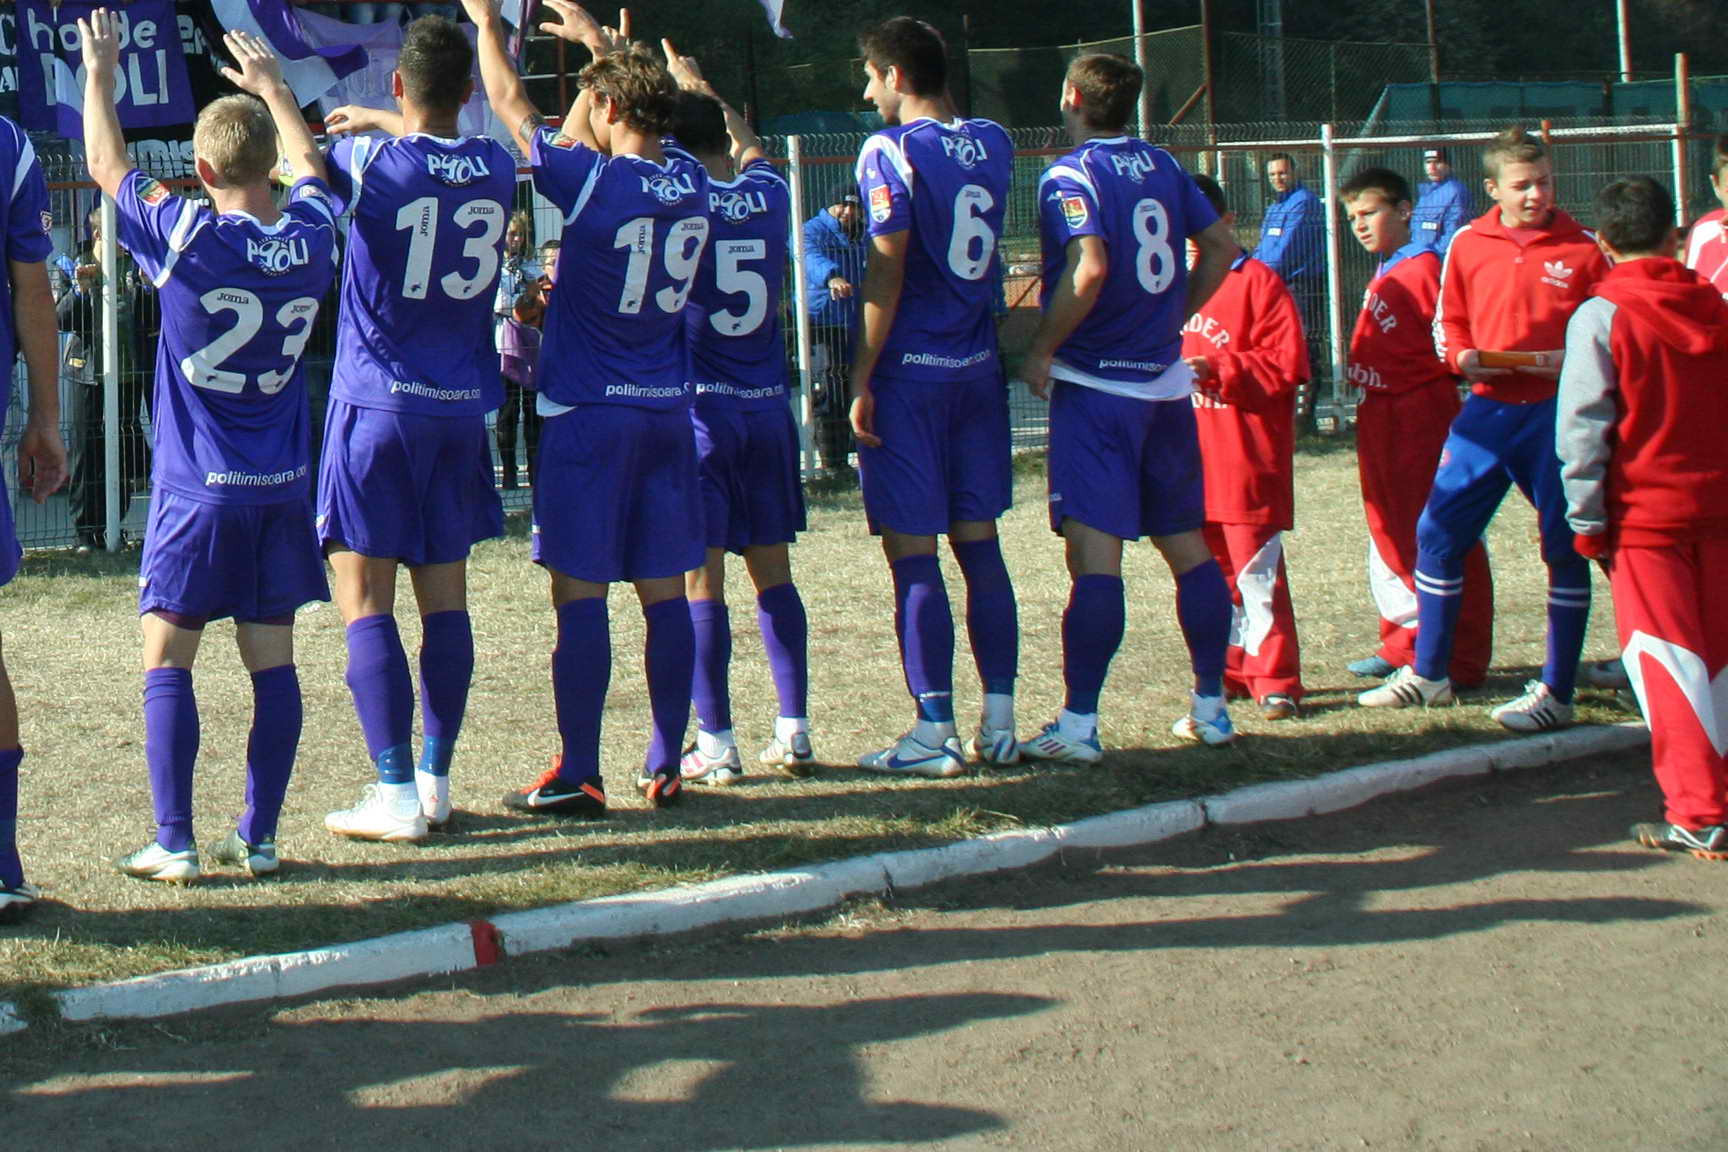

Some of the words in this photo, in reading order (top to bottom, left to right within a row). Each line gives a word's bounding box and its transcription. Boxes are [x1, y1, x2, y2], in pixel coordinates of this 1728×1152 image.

[396, 196, 505, 301] 13
[613, 215, 710, 314] 19
[947, 183, 995, 281] 6
[1132, 197, 1175, 295] 8
[708, 238, 768, 337] 5
[180, 287, 320, 395] 23
